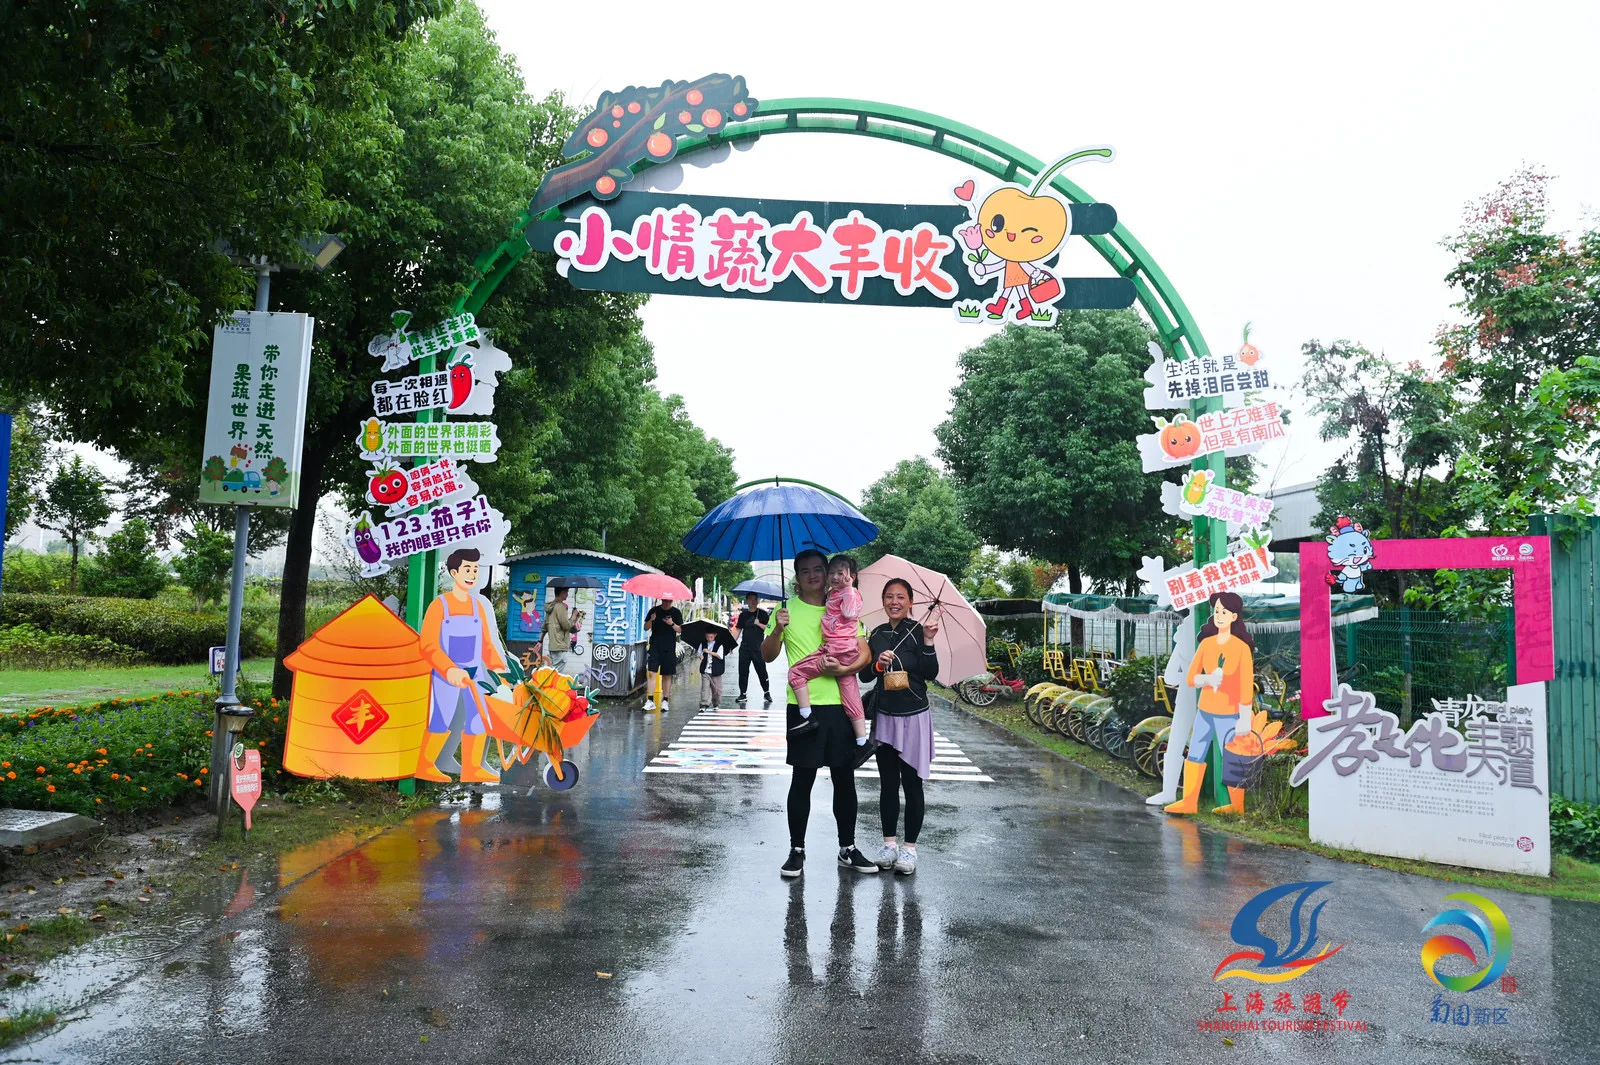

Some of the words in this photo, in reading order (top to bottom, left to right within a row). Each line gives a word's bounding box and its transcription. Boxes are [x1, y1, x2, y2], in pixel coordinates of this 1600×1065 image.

[559, 210, 955, 295] 小情蔬大丰收
[411, 327, 478, 359] 此生不重来
[1165, 355, 1238, 379] 生活就是
[374, 373, 448, 395] 每一次相遇
[1168, 369, 1269, 399] 先掉泪后尝甜
[228, 363, 252, 440] 果蔬世界
[254, 344, 280, 460] 带你走进天然
[376, 387, 449, 413] 都在脸红
[387, 424, 492, 439] 外面的世界很精彩
[1199, 402, 1279, 433] 世上无难事
[387, 439, 492, 454] 外面的世界也挺晒
[1203, 420, 1285, 451] 但是有南瓜
[385, 518, 492, 558] 我的眼里只有你
[1167, 552, 1257, 596] 别看我姓胡
[1173, 570, 1261, 609] 但是我从来不胡来
[603, 573, 629, 644] 自行车
